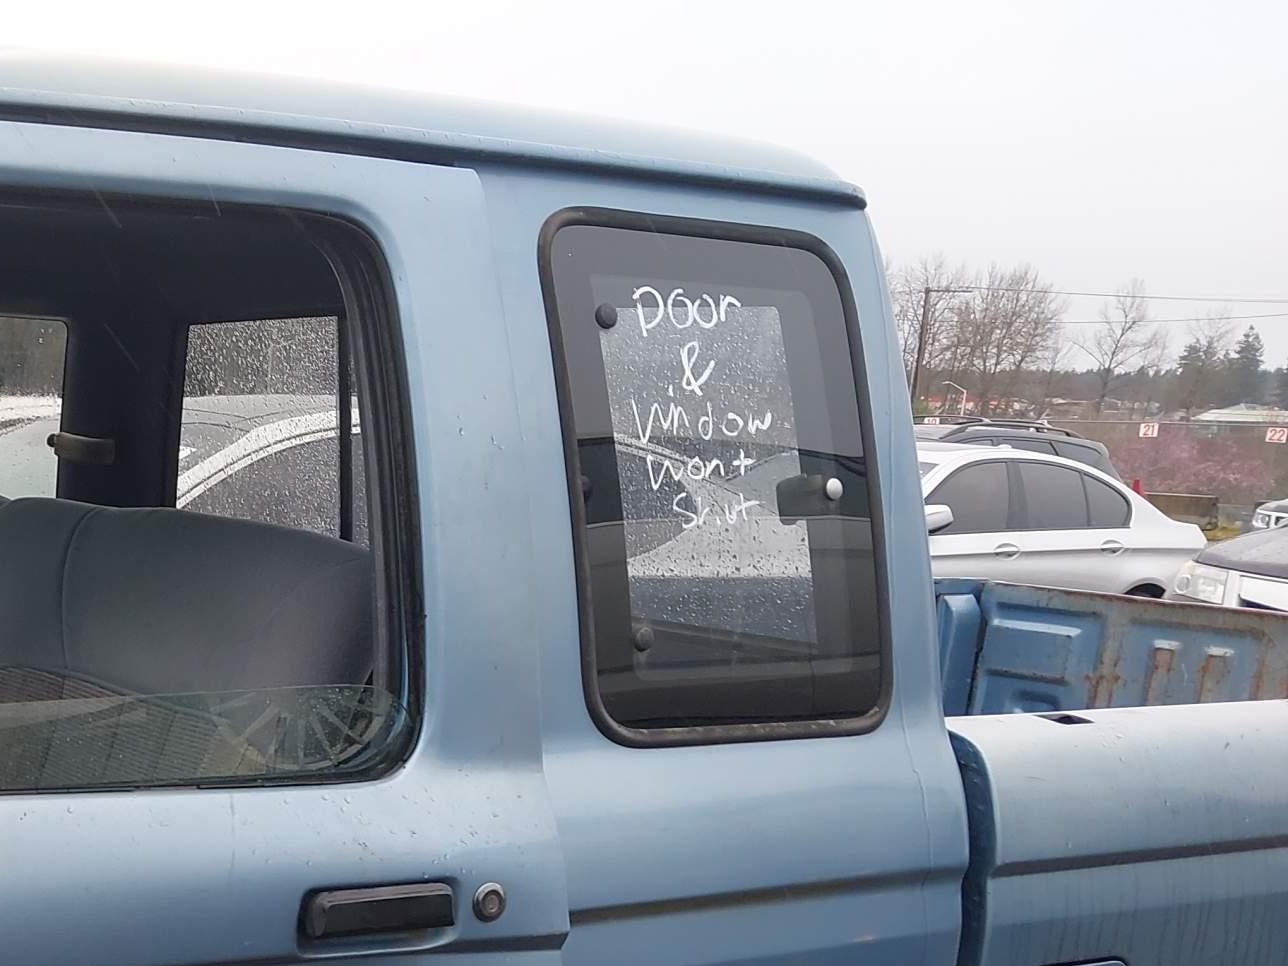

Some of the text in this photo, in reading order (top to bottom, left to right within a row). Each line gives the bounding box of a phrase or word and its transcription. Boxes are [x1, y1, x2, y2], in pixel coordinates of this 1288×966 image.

[679, 341, 715, 396] &
[1142, 424, 1155, 437] 21
[1268, 428, 1286, 442] 22
